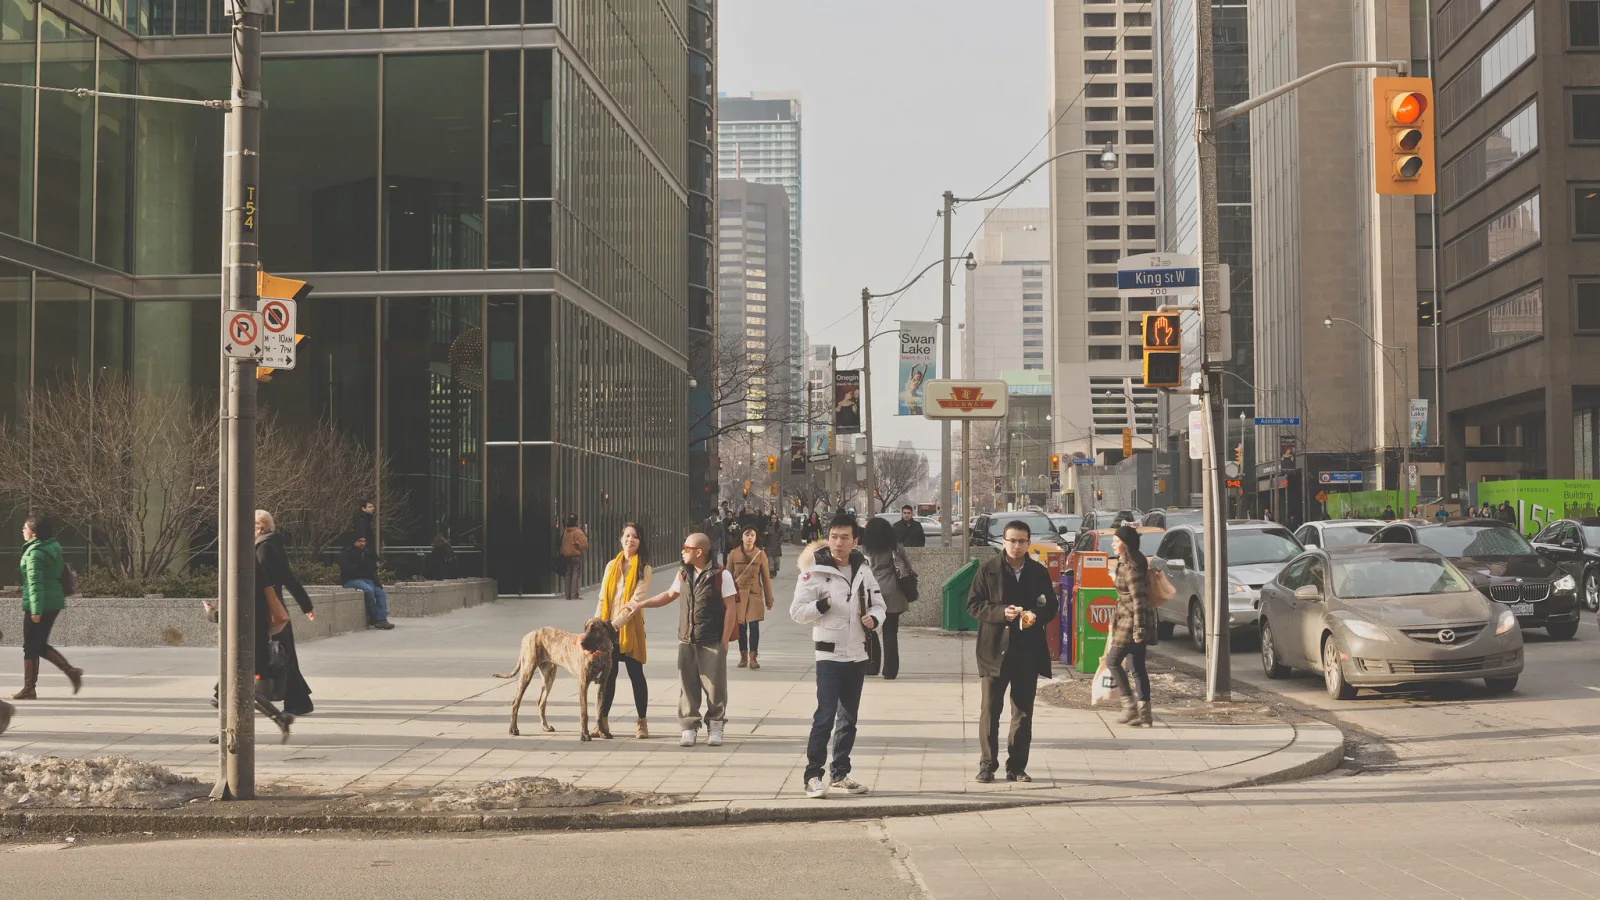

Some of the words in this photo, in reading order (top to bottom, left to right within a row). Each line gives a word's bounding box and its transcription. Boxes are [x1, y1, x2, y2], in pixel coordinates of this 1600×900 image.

[1136, 271, 1161, 286] King
[1165, 272, 1174, 283] St
[1176, 270, 1185, 282] W
[278, 334, 292, 343] 10AM
[901, 333, 935, 344] Swan
[280, 344, 292, 353] 7PM
[901, 344, 931, 355] Lake
[1563, 490, 1593, 500] Building
